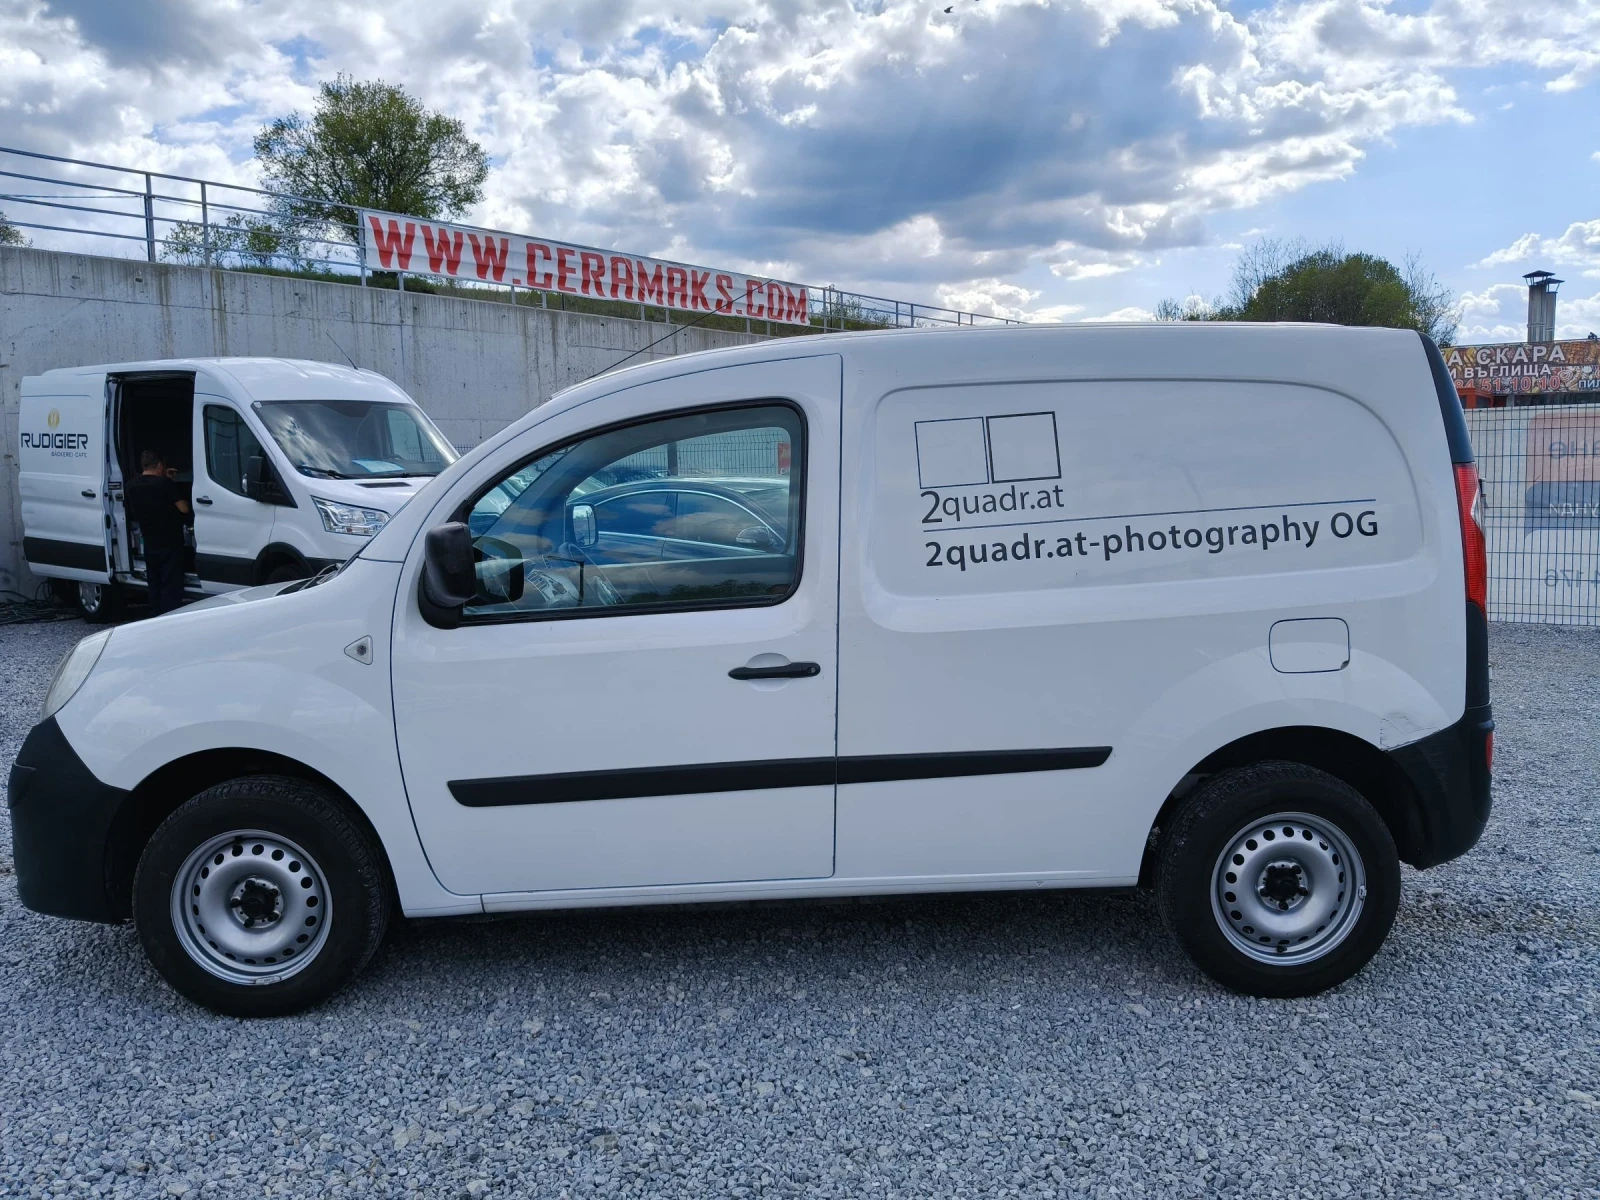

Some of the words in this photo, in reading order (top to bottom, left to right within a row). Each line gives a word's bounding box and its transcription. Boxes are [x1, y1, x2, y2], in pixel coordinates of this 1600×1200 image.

[369, 216, 808, 324] WWW.CERAMAKS.COM
[1476, 345, 1566, 365] СКАРА
[1464, 364, 1552, 379] ВЪГЛИЩА
[1481, 378, 1501, 392] 51
[1510, 376, 1532, 391] 10
[1539, 375, 1561, 390] 10
[21, 432, 88, 449] RUDIGIER
[920, 484, 1065, 524] 2quadr.at
[925, 515, 1320, 572] 2quadr.at-photography
[1330, 510, 1379, 540] OG
